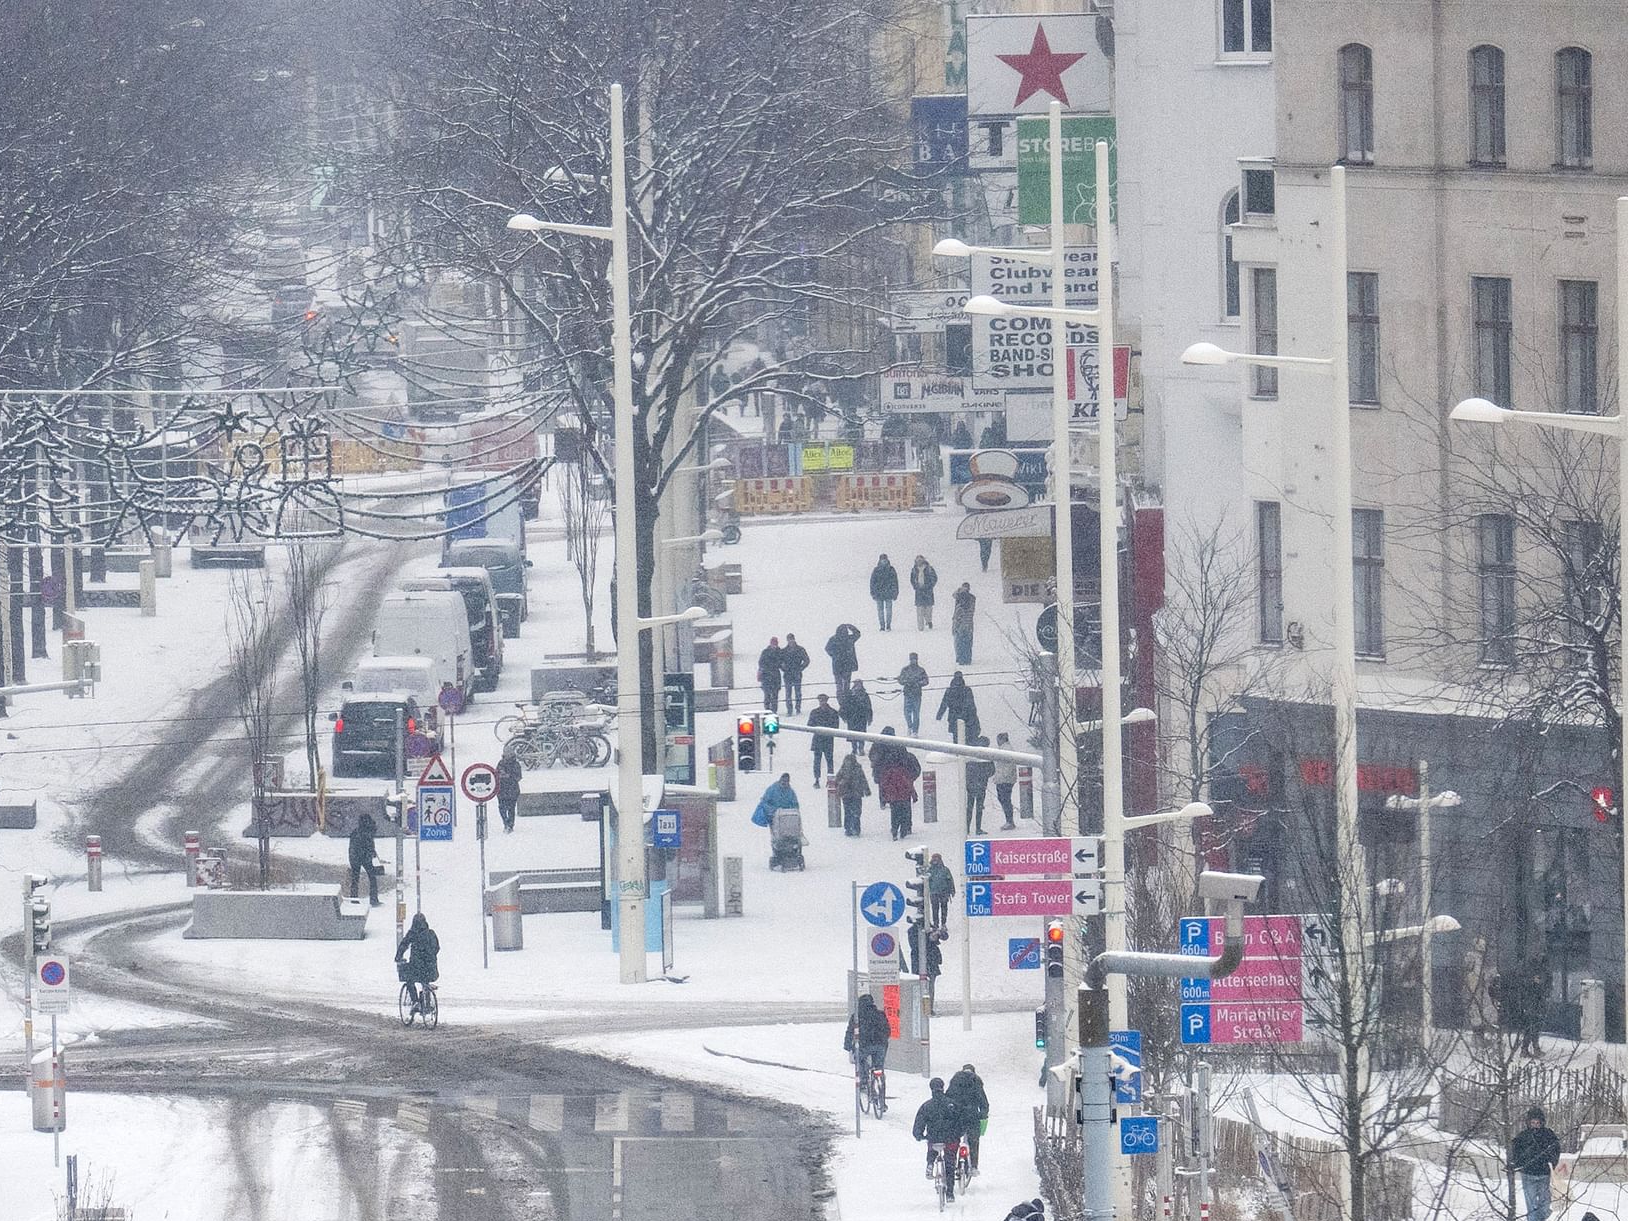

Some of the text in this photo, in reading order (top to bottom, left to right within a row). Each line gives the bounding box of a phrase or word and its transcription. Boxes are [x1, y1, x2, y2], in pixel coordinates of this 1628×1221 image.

[990, 283, 1033, 295] 2nd
[988, 330, 1100, 347] RECODS
[990, 364, 1054, 378] SHO
[1073, 403, 1117, 418] KF
[1012, 584, 1040, 596] DIE
[438, 813, 449, 822] 20
[659, 819, 676, 829] Taxi
[425, 828, 447, 837] Zone
[973, 847, 985, 861] P
[994, 850, 1069, 864] Kaiserstraße
[967, 863, 990, 873] 700m
[973, 885, 986, 902] P
[994, 892, 1070, 905] Stafa Tower
[969, 904, 991, 914] 150m
[1188, 926, 1201, 943] P
[1181, 943, 1208, 955] 660m
[1183, 987, 1210, 999] 600m
[1216, 1007, 1296, 1023] Mariahilfer
[1190, 1019, 1203, 1035] P
[1233, 1025, 1281, 1039] Straße
